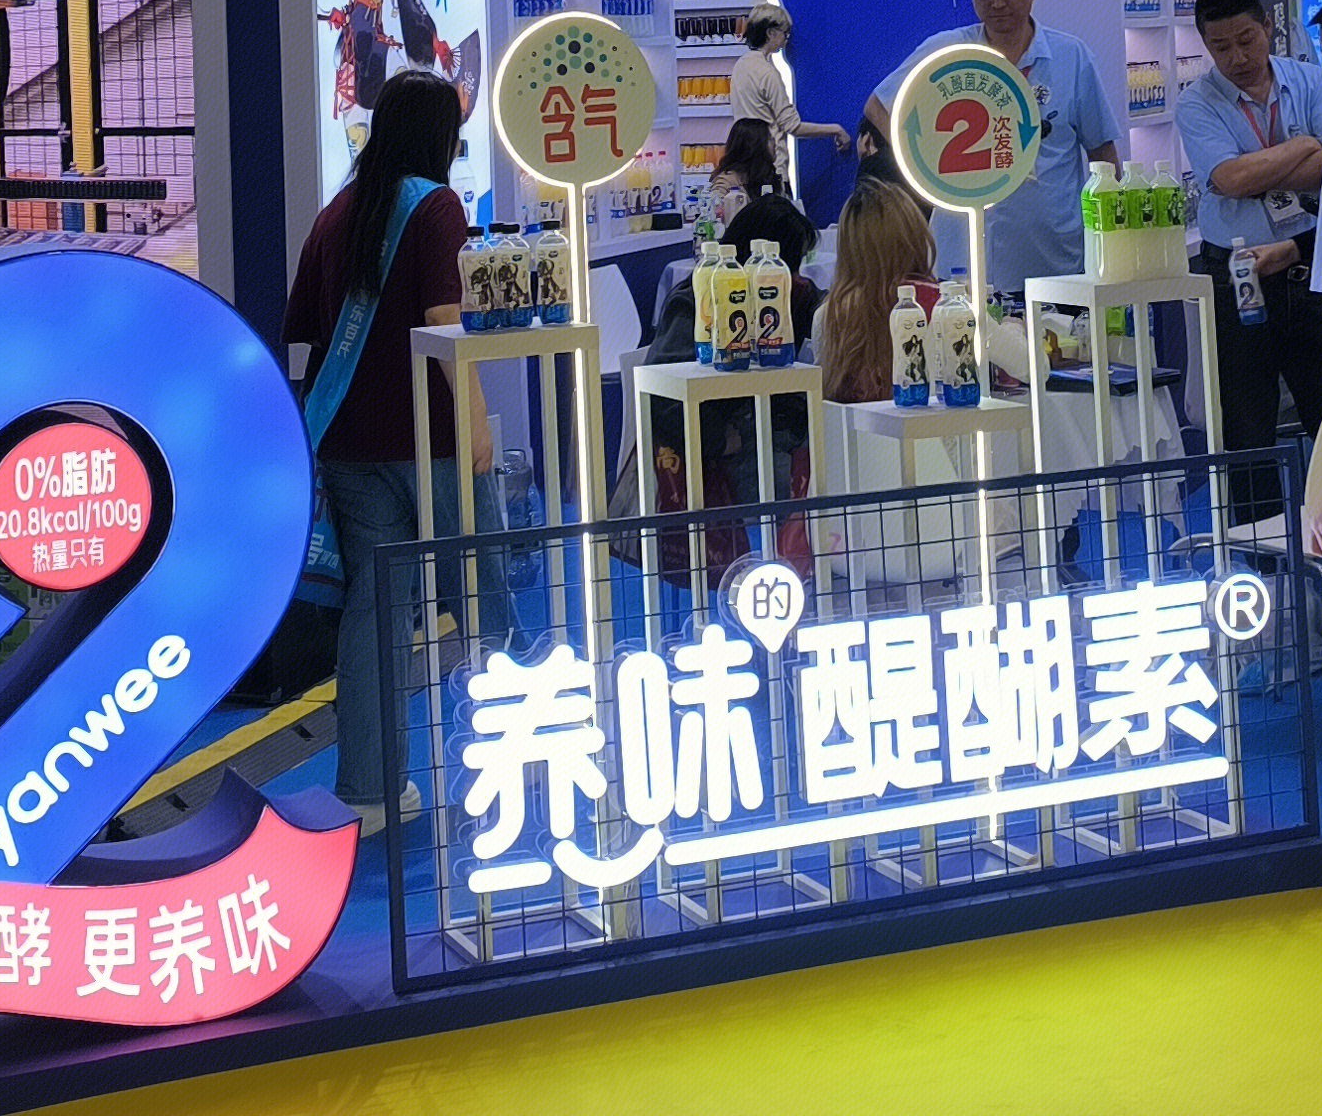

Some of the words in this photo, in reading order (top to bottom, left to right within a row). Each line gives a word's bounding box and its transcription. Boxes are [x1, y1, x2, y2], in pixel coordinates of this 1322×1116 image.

[540, 84, 624, 164] 含气
[935, 98, 992, 175] 2
[992, 115, 1014, 169] 次发酵
[14, 447, 117, 502] 0%脂肪
[32, 534, 105, 573] 热量只有
[76, 873, 292, 1004] 更养味
